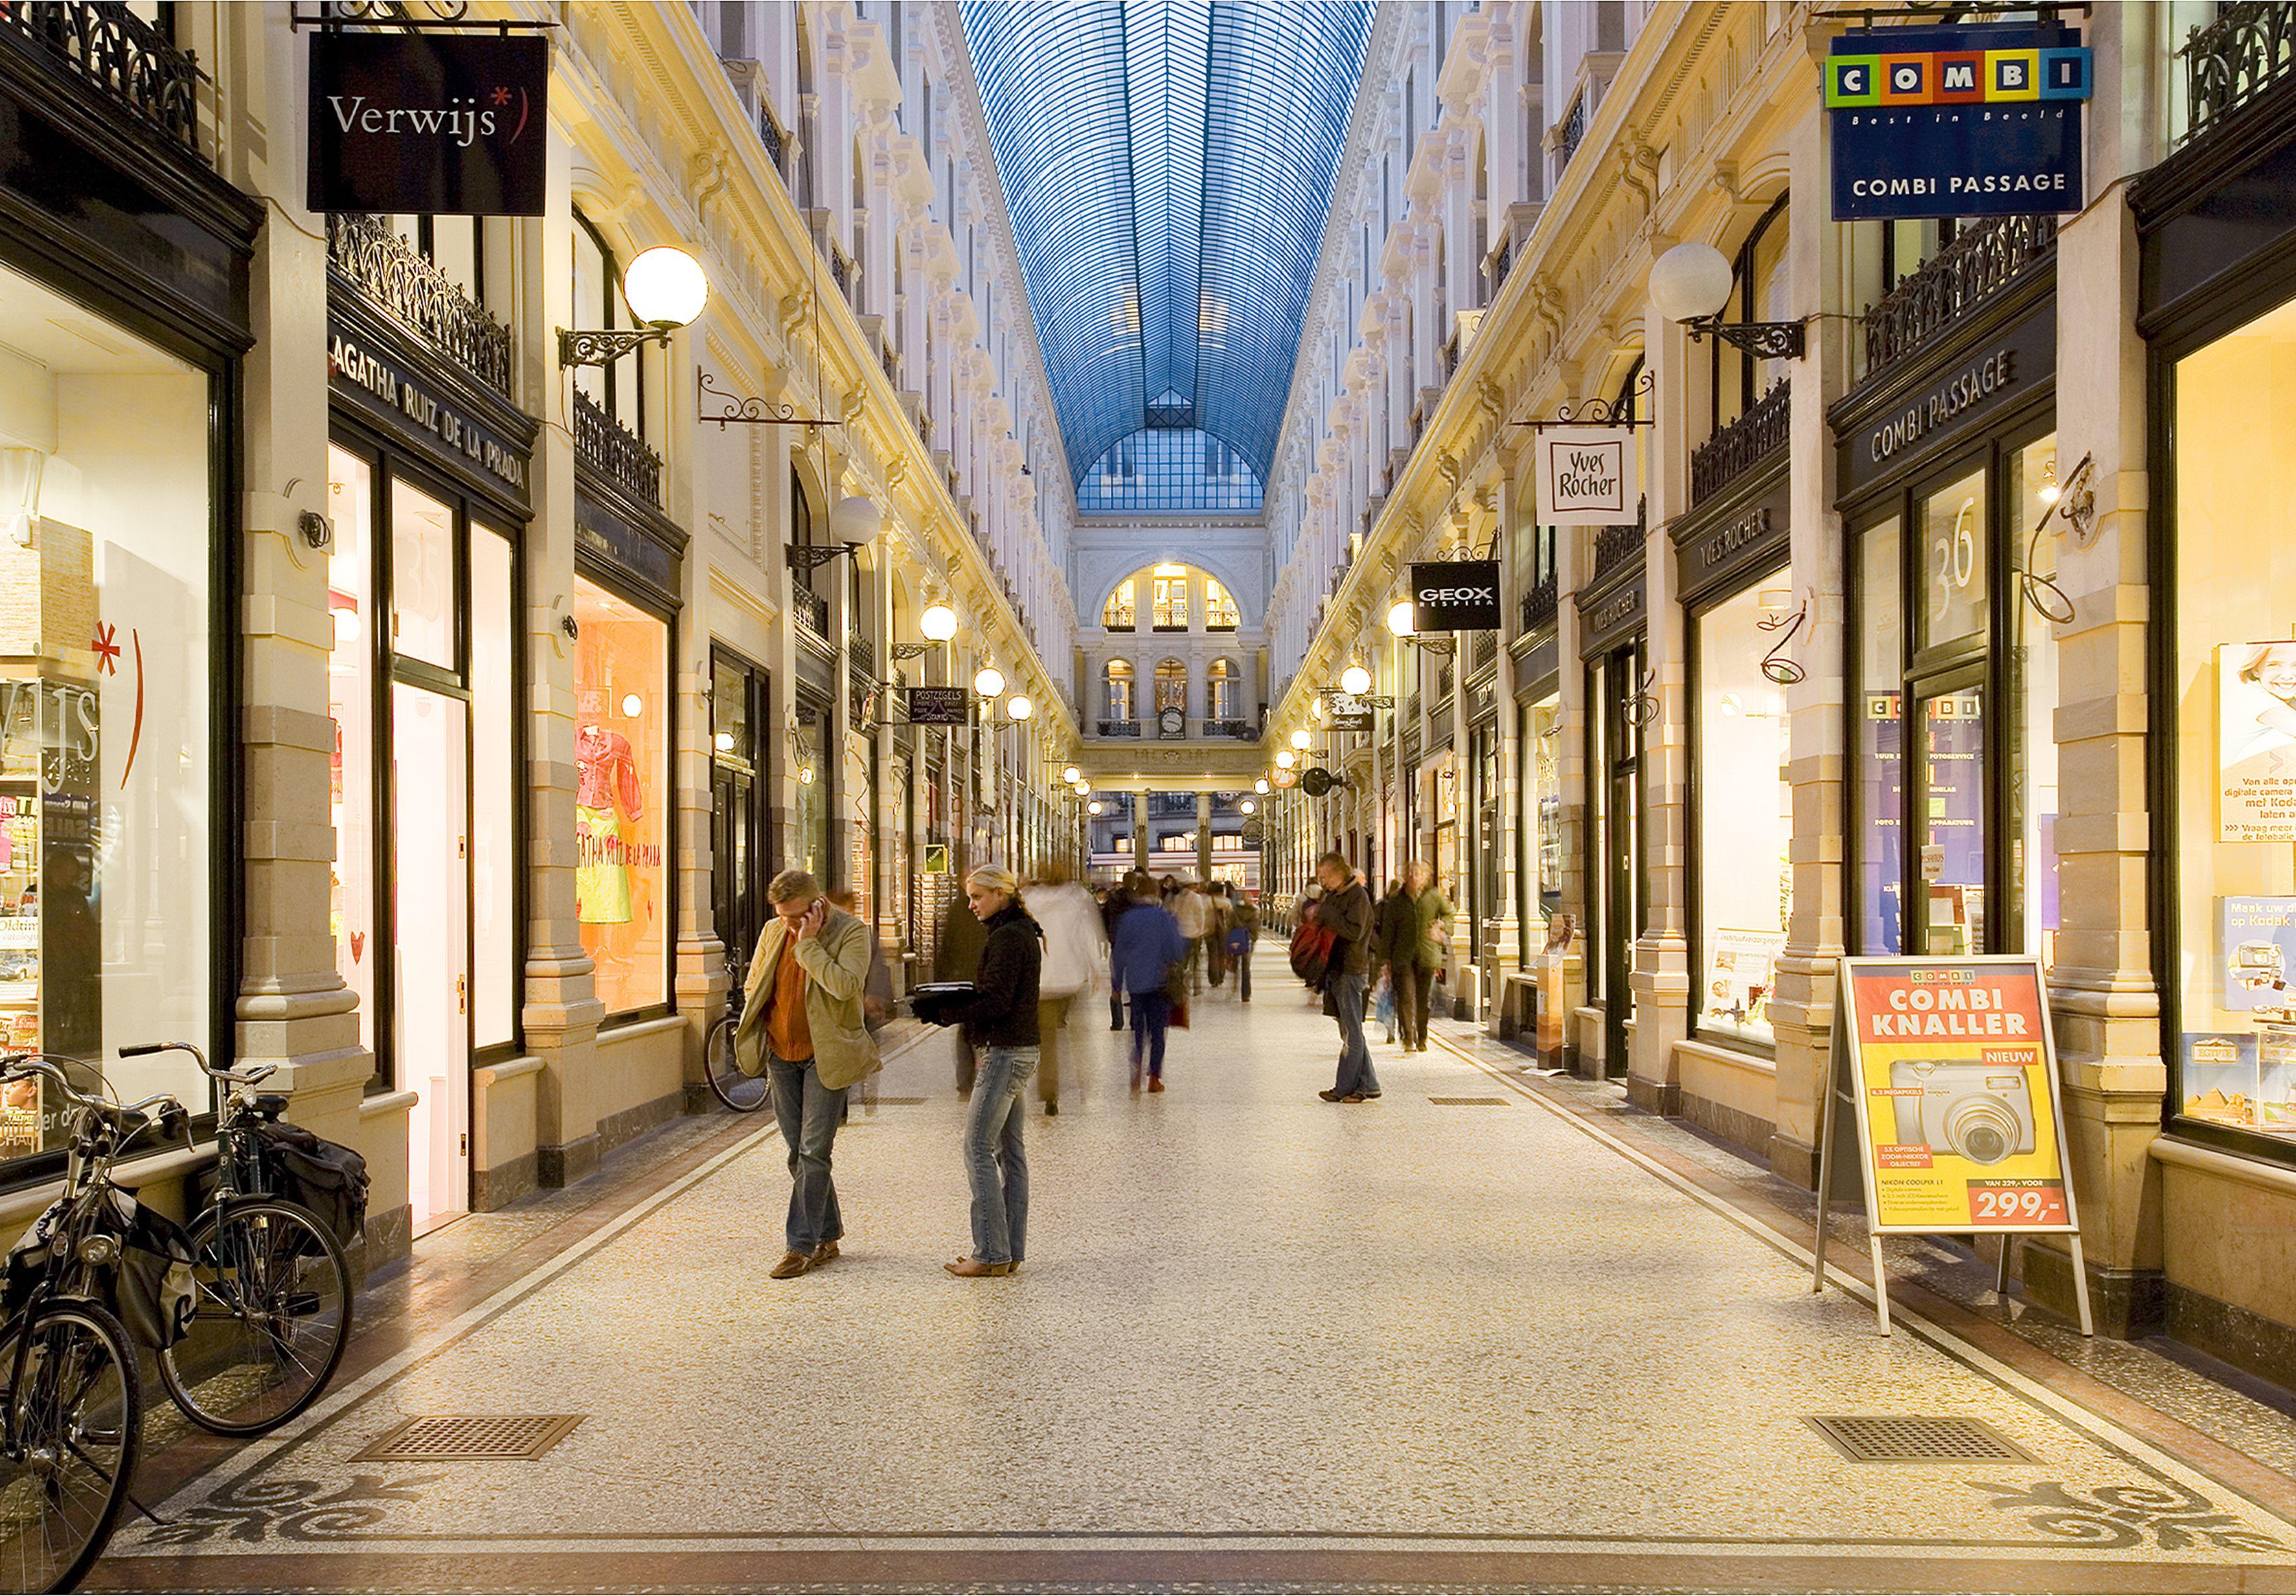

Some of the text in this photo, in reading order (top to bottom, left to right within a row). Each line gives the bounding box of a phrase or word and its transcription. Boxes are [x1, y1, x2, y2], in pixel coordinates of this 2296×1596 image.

[1844, 63, 2071, 92] COMBI
[327, 96, 496, 146] Verwijs
[1852, 109, 2063, 126] Best in Beeld
[1853, 174, 2065, 196] COMBI PASSAGE
[333, 334, 525, 490] AGATHA RUIZ DE LA PRADA
[1871, 349, 2006, 462] COMBI PASSAGE
[1570, 451, 1604, 476] Yves
[1559, 472, 1617, 499] Rocher
[1700, 507, 1768, 569] YVES ROCHER
[1934, 497, 1975, 622] 36
[1418, 587, 1493, 601] GEOX
[915, 690, 962, 700] POSTZEGELS
[2224, 788, 2257, 799] digitale
[2245, 797, 2267, 807] met
[2260, 810, 2286, 819] laten
[2241, 824, 2268, 832] Vraag
[2231, 903, 2262, 913] Maak
[2266, 904, 2283, 913] uw
[2231, 915, 2290, 928] op Kodak
[1889, 988, 2003, 1011] COMBI
[1872, 1012, 2029, 1036] KNALLER
[1986, 1051, 2034, 1063] NIEUW
[2198, 1049, 2233, 1057] EGYPTE
[1977, 1191, 2060, 1222] 299,-
